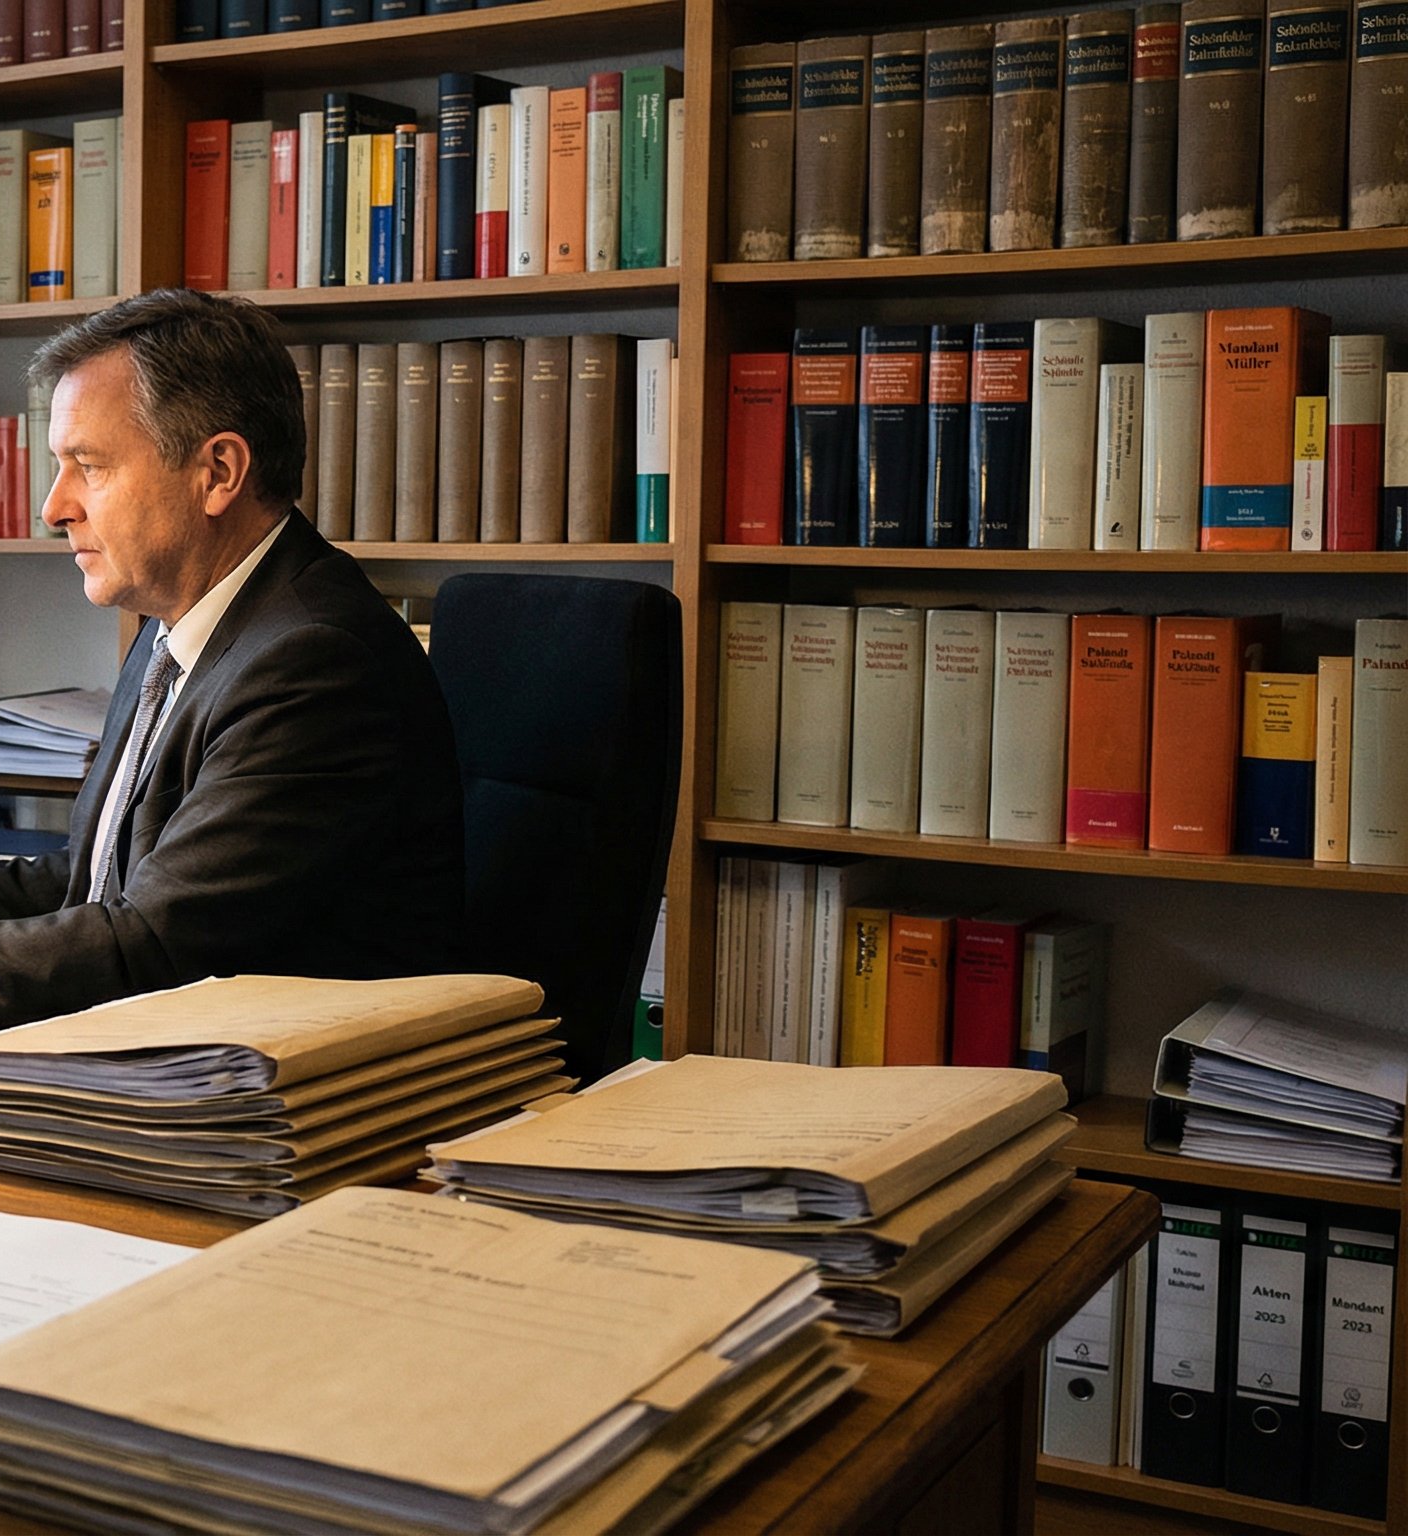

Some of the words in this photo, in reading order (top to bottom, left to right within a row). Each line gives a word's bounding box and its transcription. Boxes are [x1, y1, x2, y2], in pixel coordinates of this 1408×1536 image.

[1219, 341, 1279, 354] Mandant
[1225, 357, 1272, 369] Müller
[1252, 1285, 1291, 1300] Akten
[1332, 1296, 1385, 1315] Mandant
[1254, 1310, 1286, 1325] 2023
[1342, 1320, 1373, 1334] 2023
